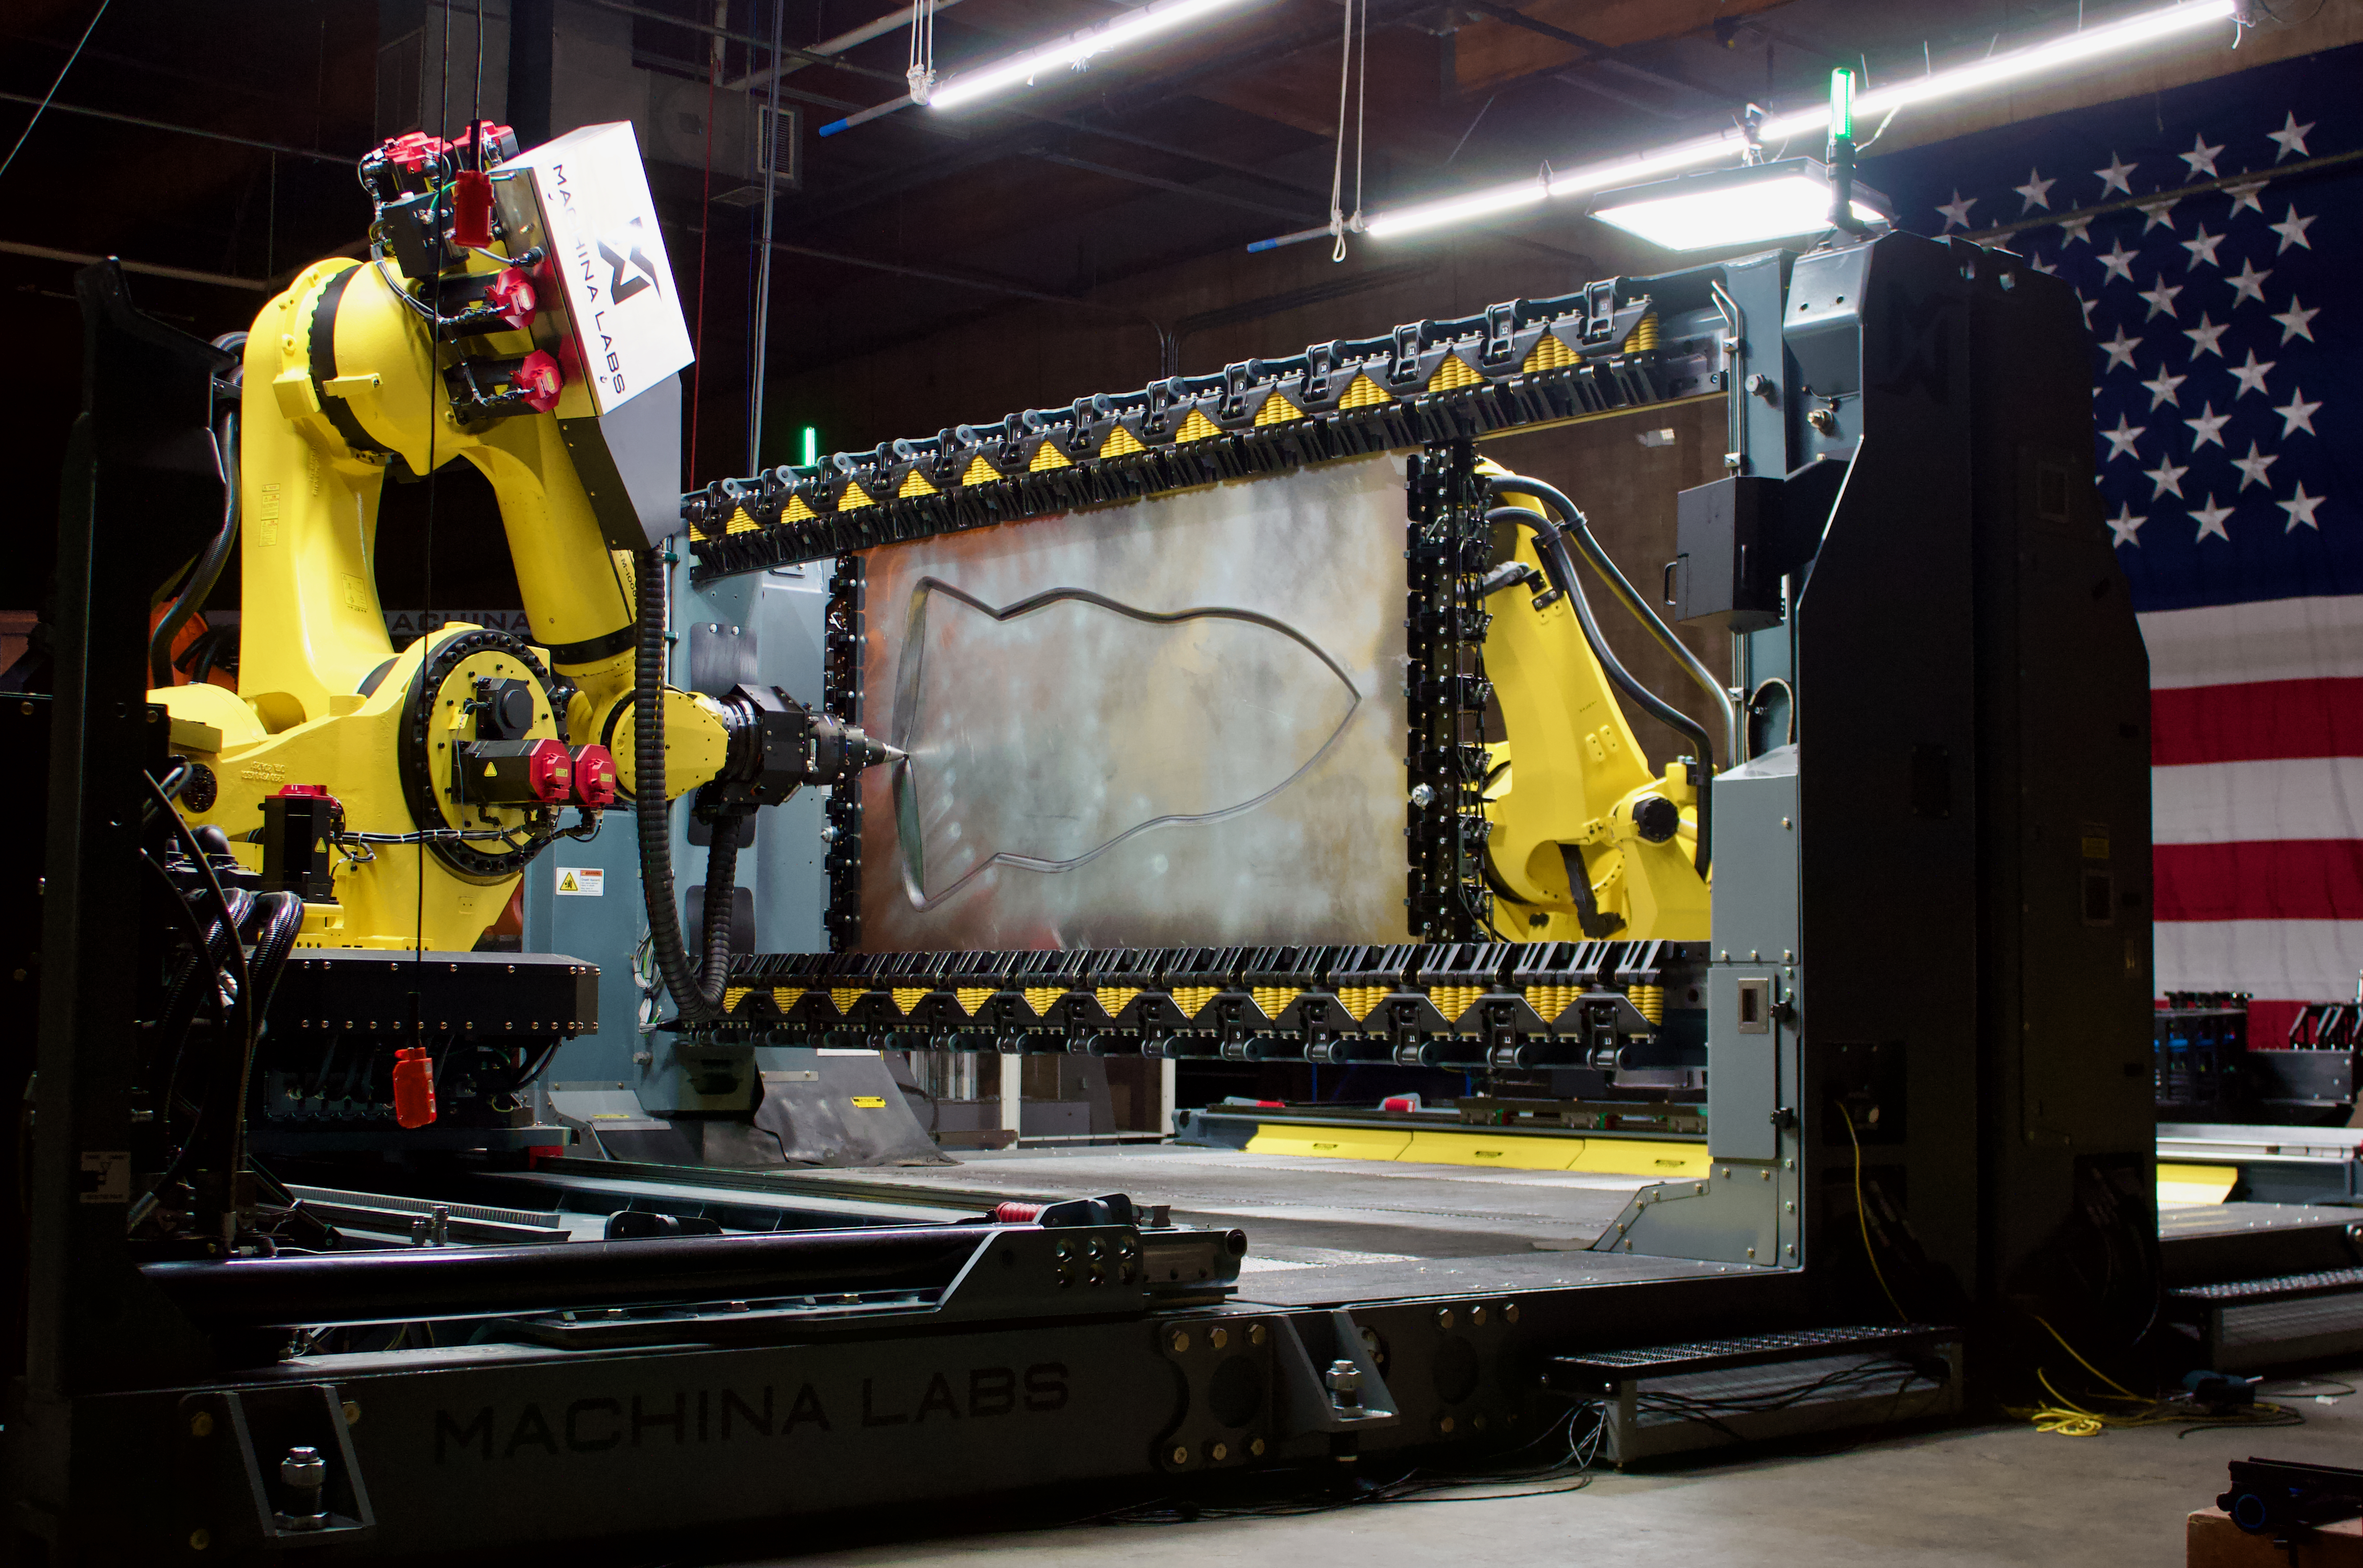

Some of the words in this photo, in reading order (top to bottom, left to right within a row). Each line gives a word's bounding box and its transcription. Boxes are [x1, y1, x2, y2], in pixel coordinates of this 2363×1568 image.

[595, 311, 625, 394] LABS
[1238, 382, 1244, 390] 9
[1161, 399, 1165, 407] 8
[1087, 415, 1091, 423] 7
[1017, 431, 1021, 439] 6
[384, 612, 531, 632] ACINA
[1236, 1031, 1240, 1040] 9
[435, 1382, 831, 1465] MACHINA
[861, 1362, 1069, 1428] LABS
